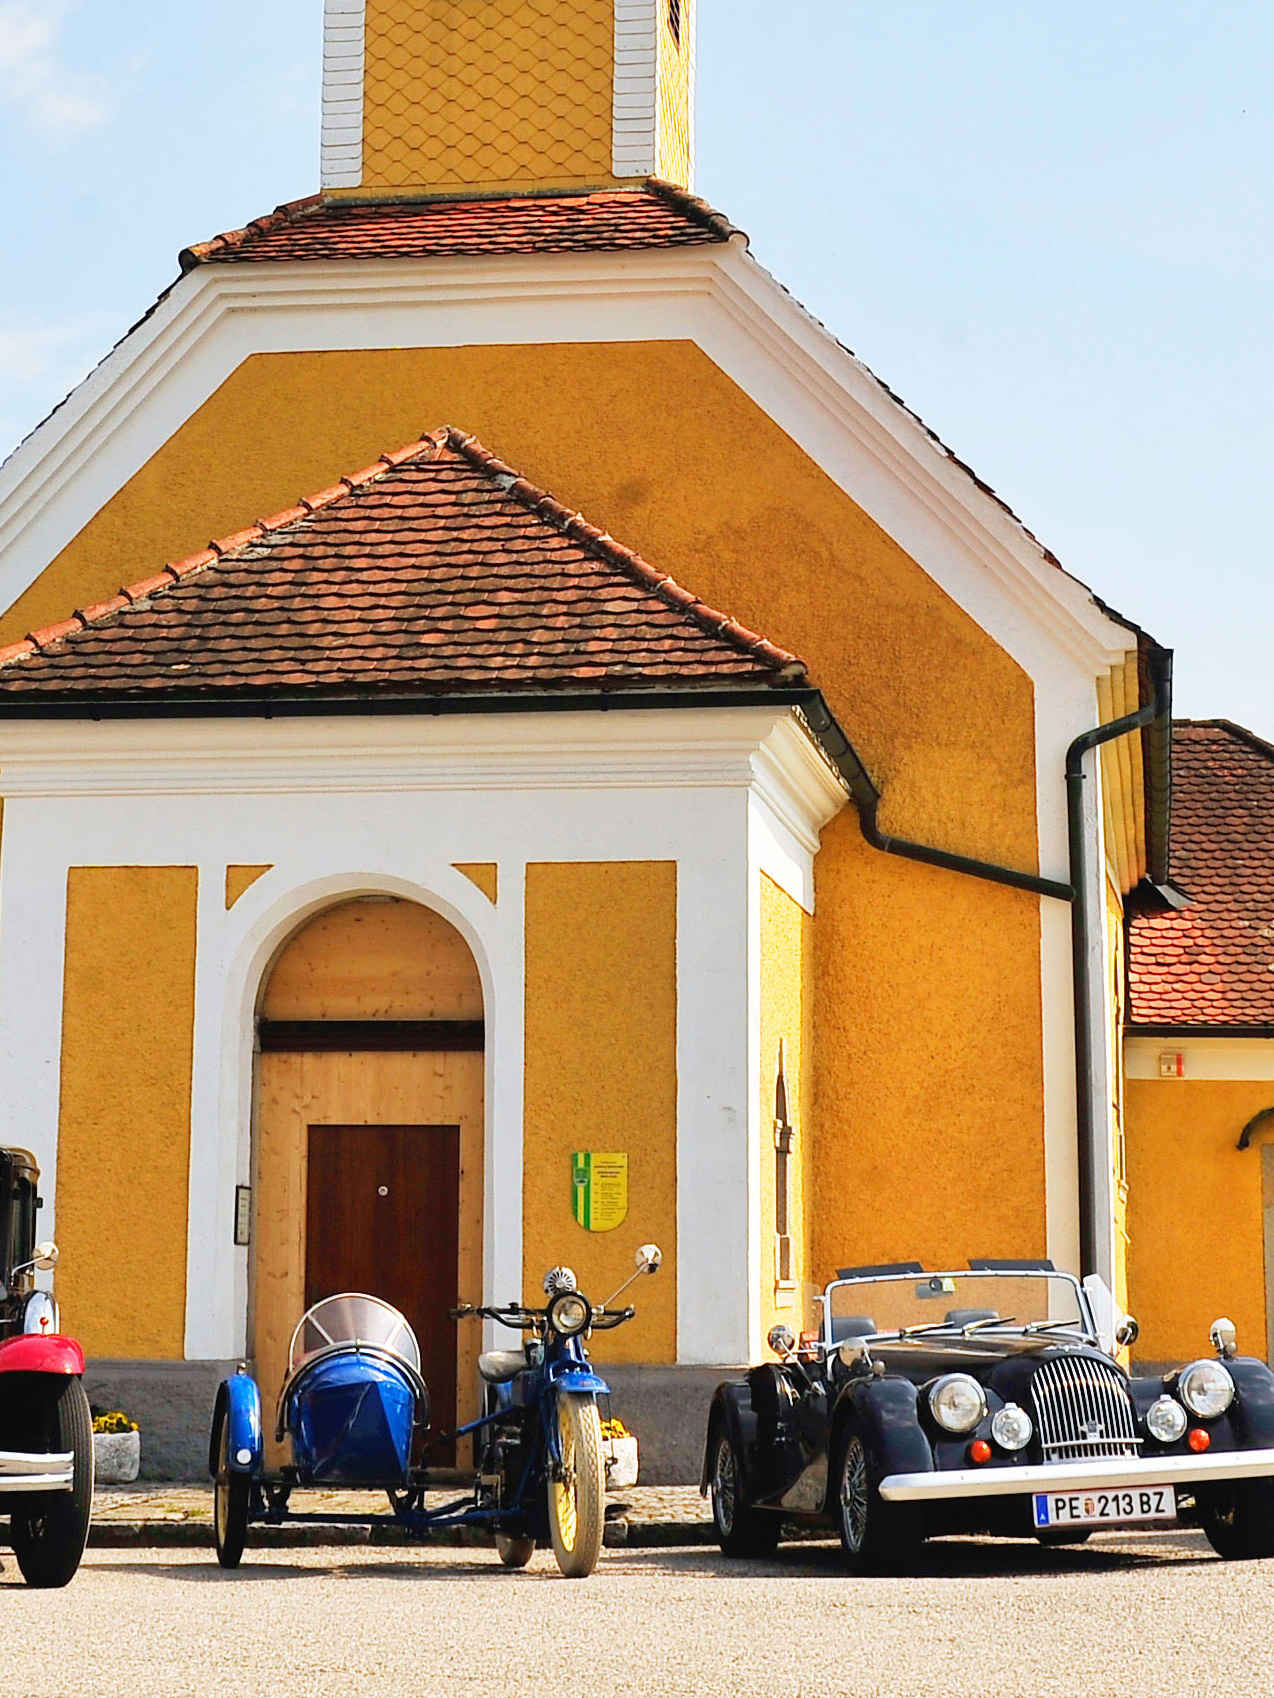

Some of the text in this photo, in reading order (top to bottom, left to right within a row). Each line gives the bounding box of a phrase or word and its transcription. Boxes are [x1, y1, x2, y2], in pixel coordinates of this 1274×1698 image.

[1054, 1497, 1081, 1520] PE
[1097, 1493, 1134, 1517] 213
[1139, 1491, 1166, 1515] BZ
